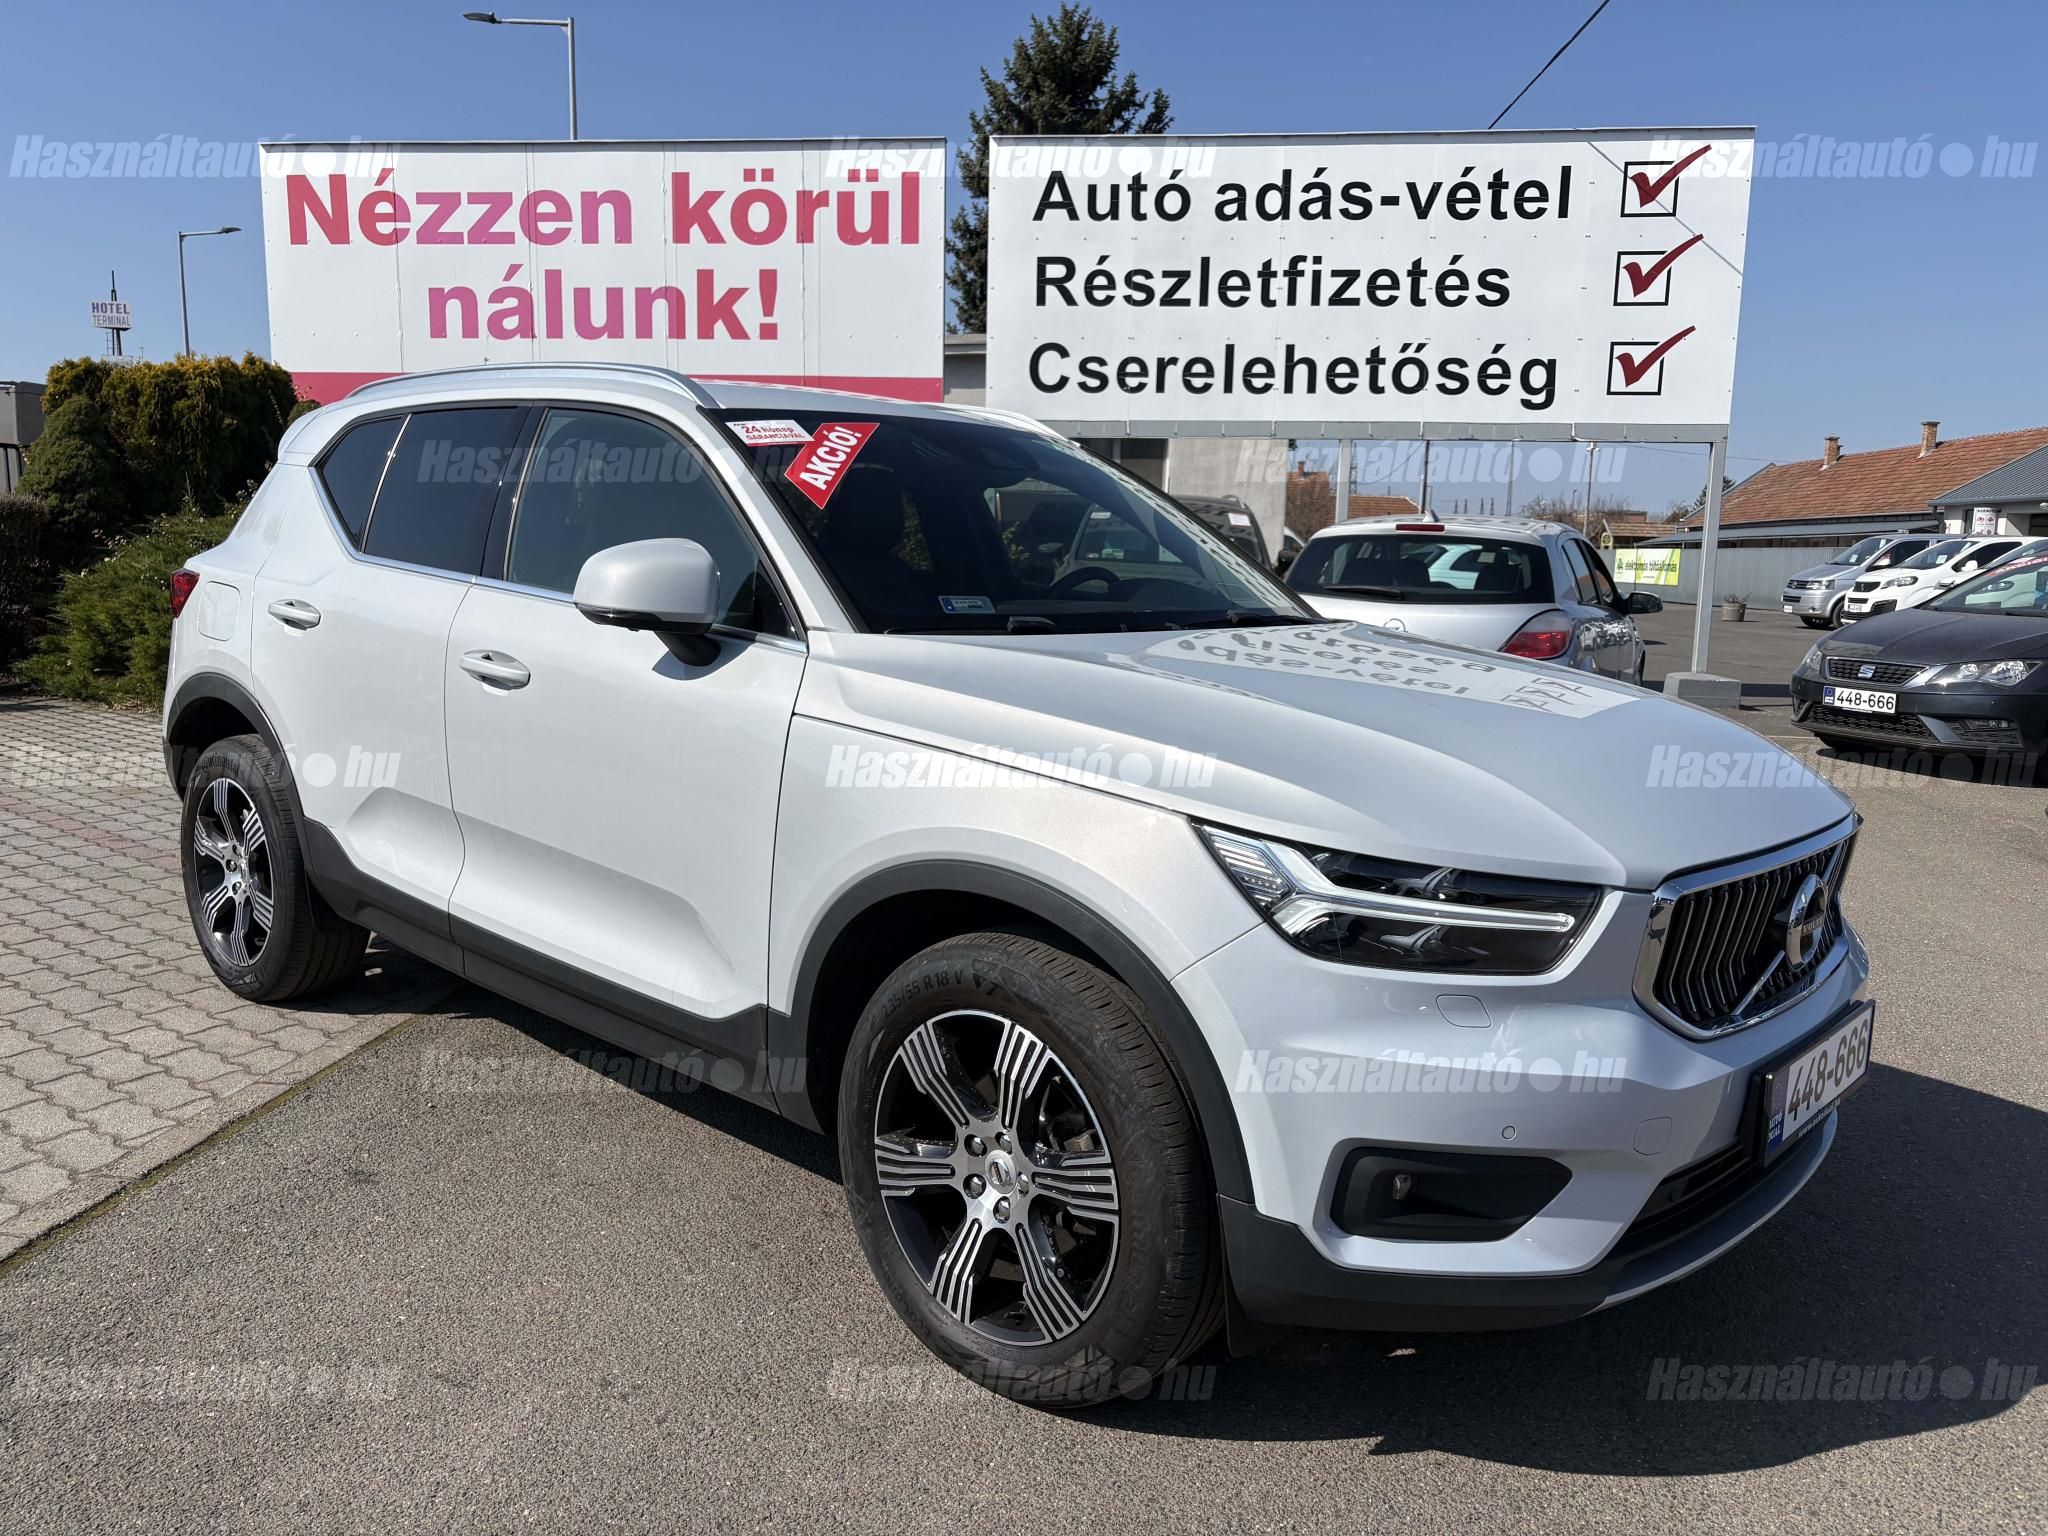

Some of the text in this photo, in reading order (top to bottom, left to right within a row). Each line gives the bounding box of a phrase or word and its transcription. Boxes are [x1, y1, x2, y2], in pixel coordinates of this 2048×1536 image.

[286, 168, 920, 246] Nézzen körül
[1032, 166, 1572, 222] Autó adás-vétel
[91, 302, 130, 314] HOTEL
[429, 264, 778, 341] nálunk!
[1036, 255, 1510, 308] Részletfizetés
[92, 314, 132, 326] TERMINAL
[1029, 343, 1557, 411] Cserelehetőség
[743, 425, 761, 434] 24
[799, 425, 864, 492] AKCIÓ!
[1836, 689, 1895, 712] 448-666
[1787, 1018, 1869, 1122] 448-666
